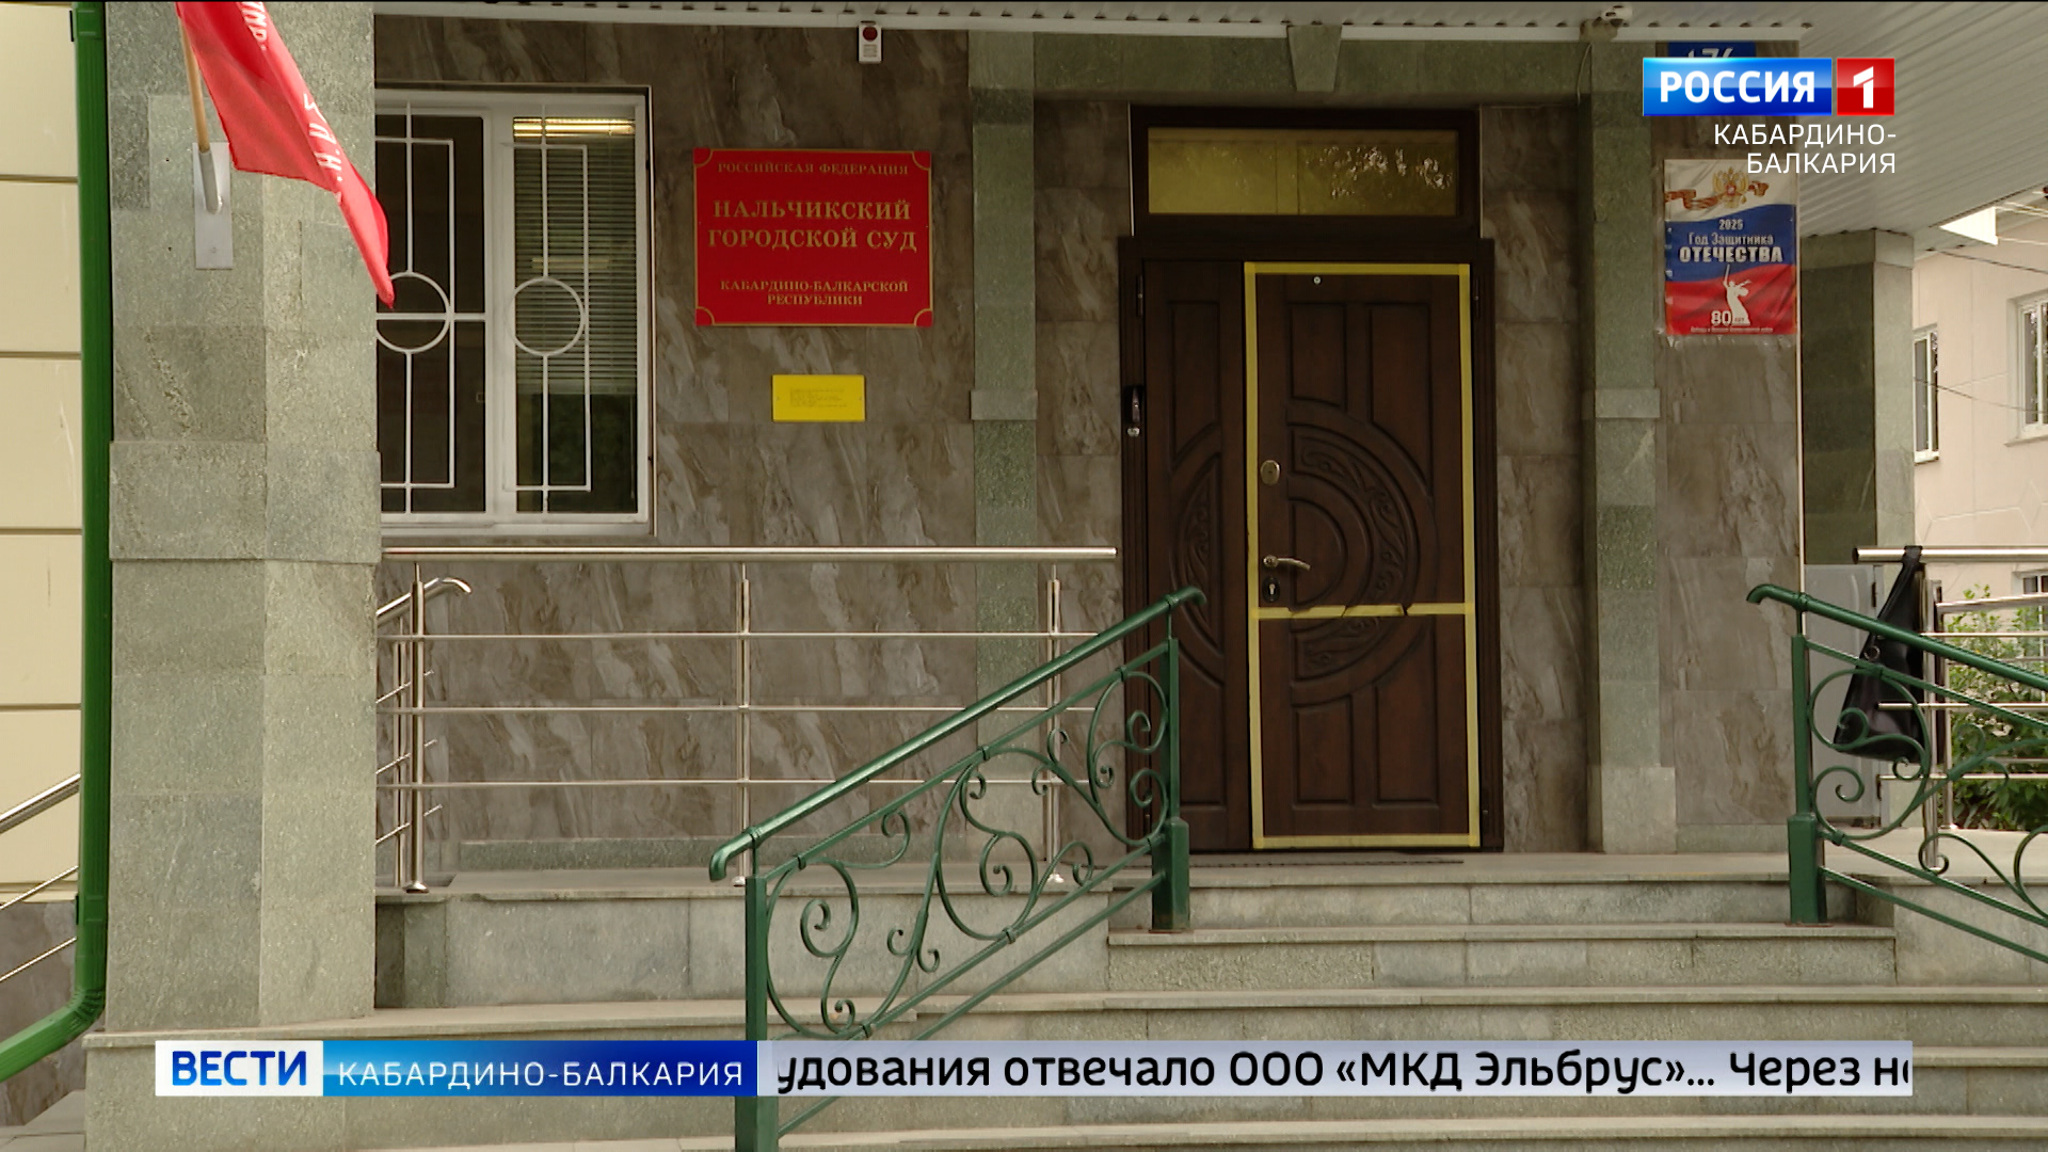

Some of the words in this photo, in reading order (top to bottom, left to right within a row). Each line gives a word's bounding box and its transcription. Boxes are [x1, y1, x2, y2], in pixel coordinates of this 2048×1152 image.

[717, 162, 815, 174] РОССИЙСКАЯ
[819, 164, 909, 176] ФЕДЕРАЦИЯ
[713, 200, 911, 220] НАЛЬЧИКСКИЙ
[708, 228, 858, 250] ГОРОДСКОЙ
[866, 231, 917, 253] СУД
[1688, 232, 1709, 246] Год
[1711, 232, 1774, 246] Защитника
[1679, 246, 1784, 263] ОТЕЧЕСТВА
[720, 280, 909, 292] КАБАРДИНО-БАЛКАРСКОЙ
[767, 294, 863, 306] РЕСПУБЛИКИ
[1711, 310, 1732, 327] 80
